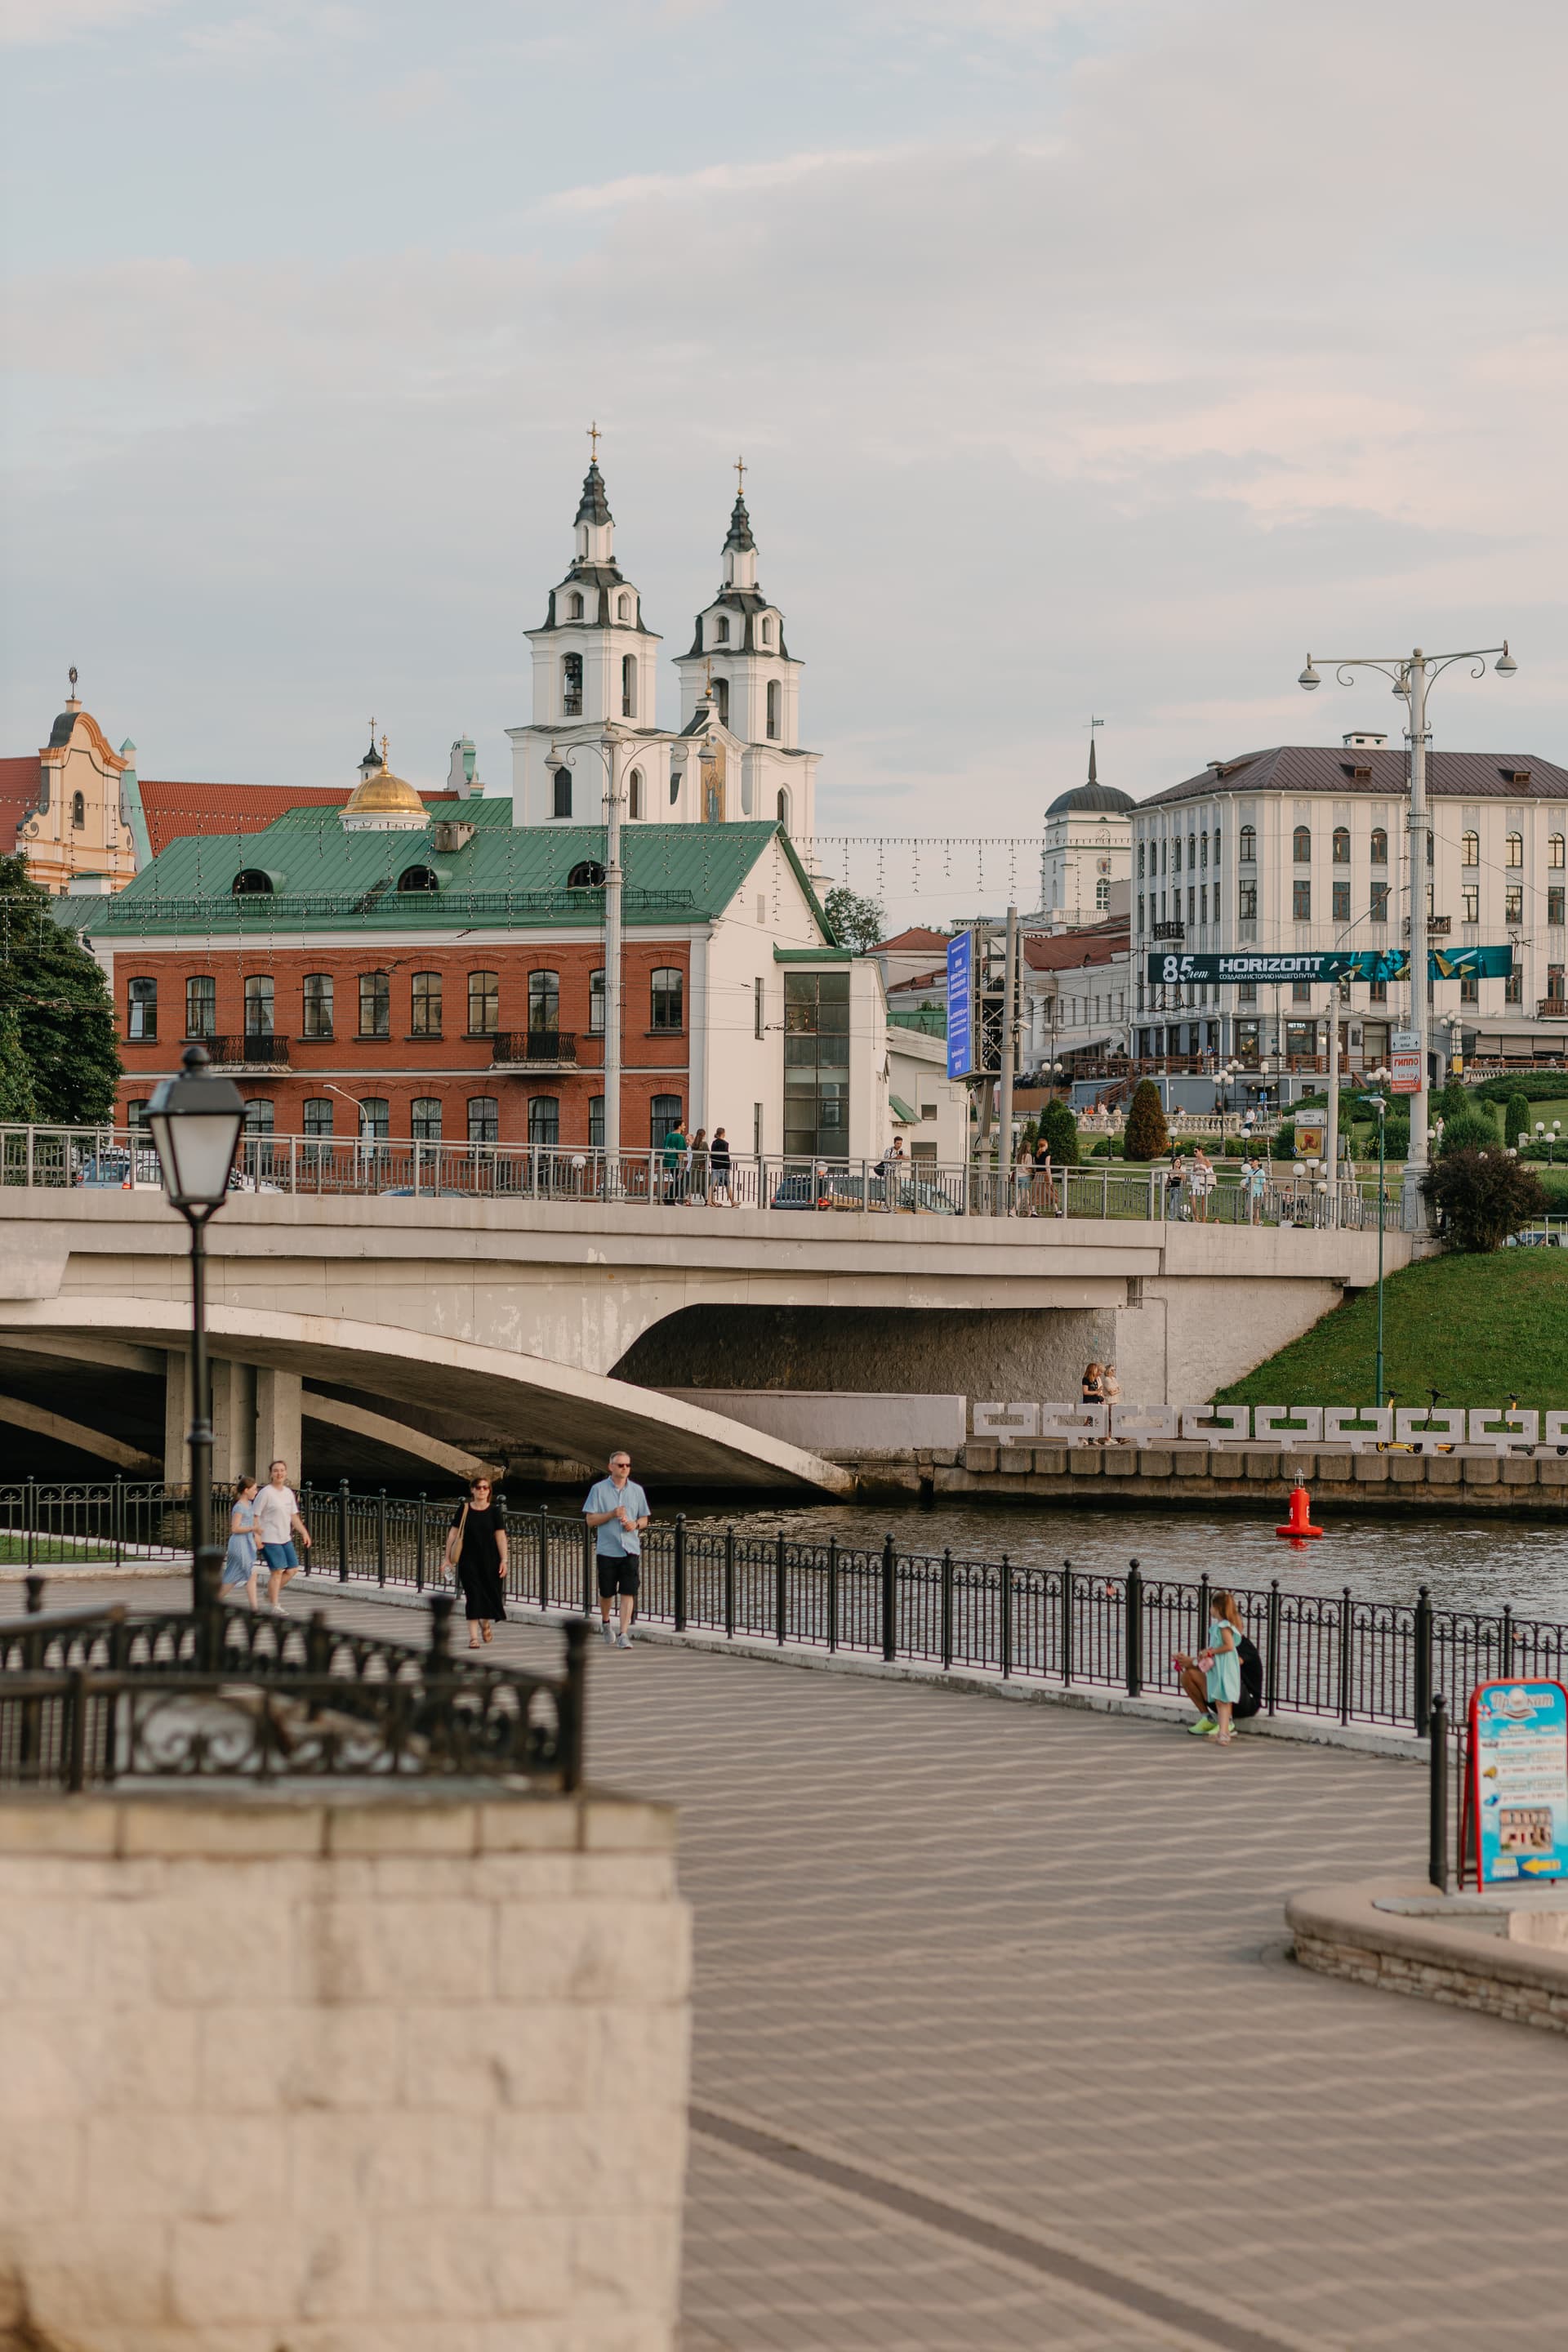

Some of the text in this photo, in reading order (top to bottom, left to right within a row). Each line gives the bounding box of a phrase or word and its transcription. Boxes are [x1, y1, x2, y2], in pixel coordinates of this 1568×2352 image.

[1163, 956, 1194, 983] 85
[1219, 957, 1325, 973] HORIZONT
[1394, 1058, 1419, 1067] ГИППО
